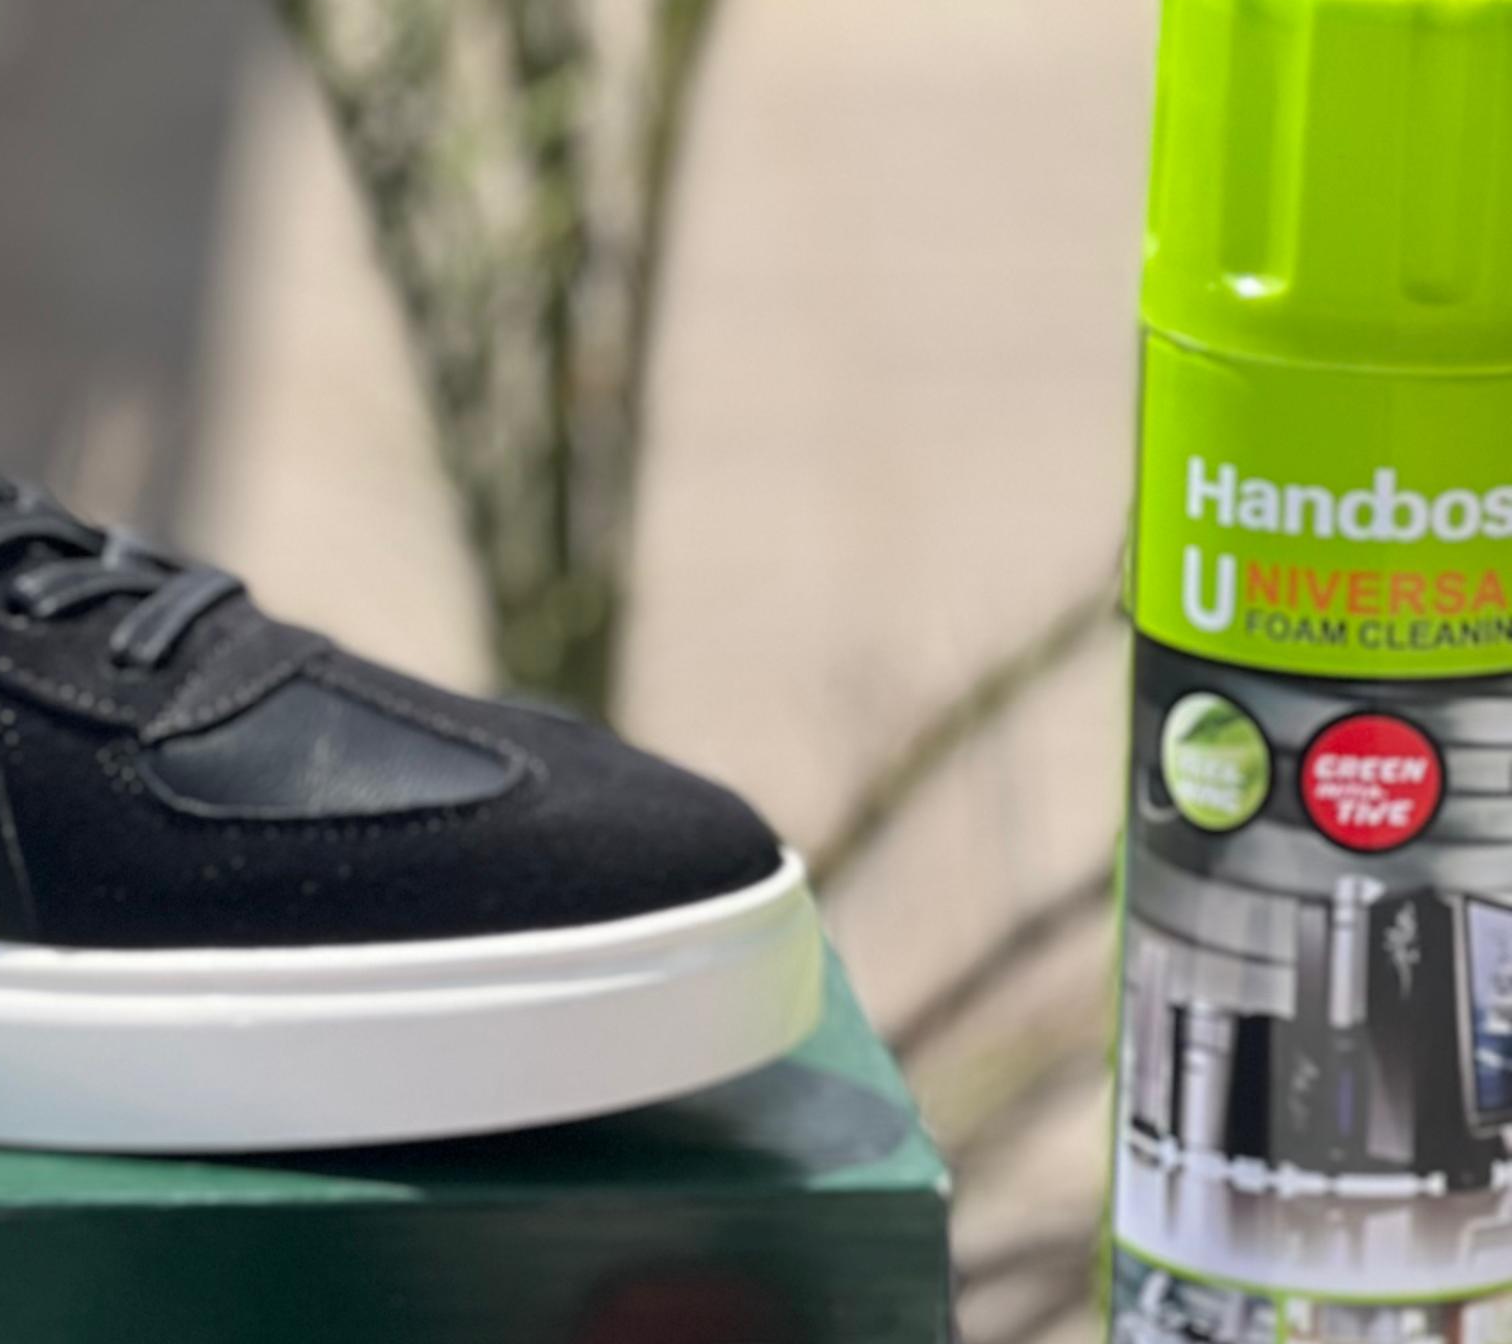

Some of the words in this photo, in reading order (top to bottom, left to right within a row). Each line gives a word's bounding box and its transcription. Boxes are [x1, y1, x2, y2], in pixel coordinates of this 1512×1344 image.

[1186, 455, 1512, 544] Handbos
[1245, 609, 1348, 648] FOAM
[1313, 752, 1429, 785] GREEN
